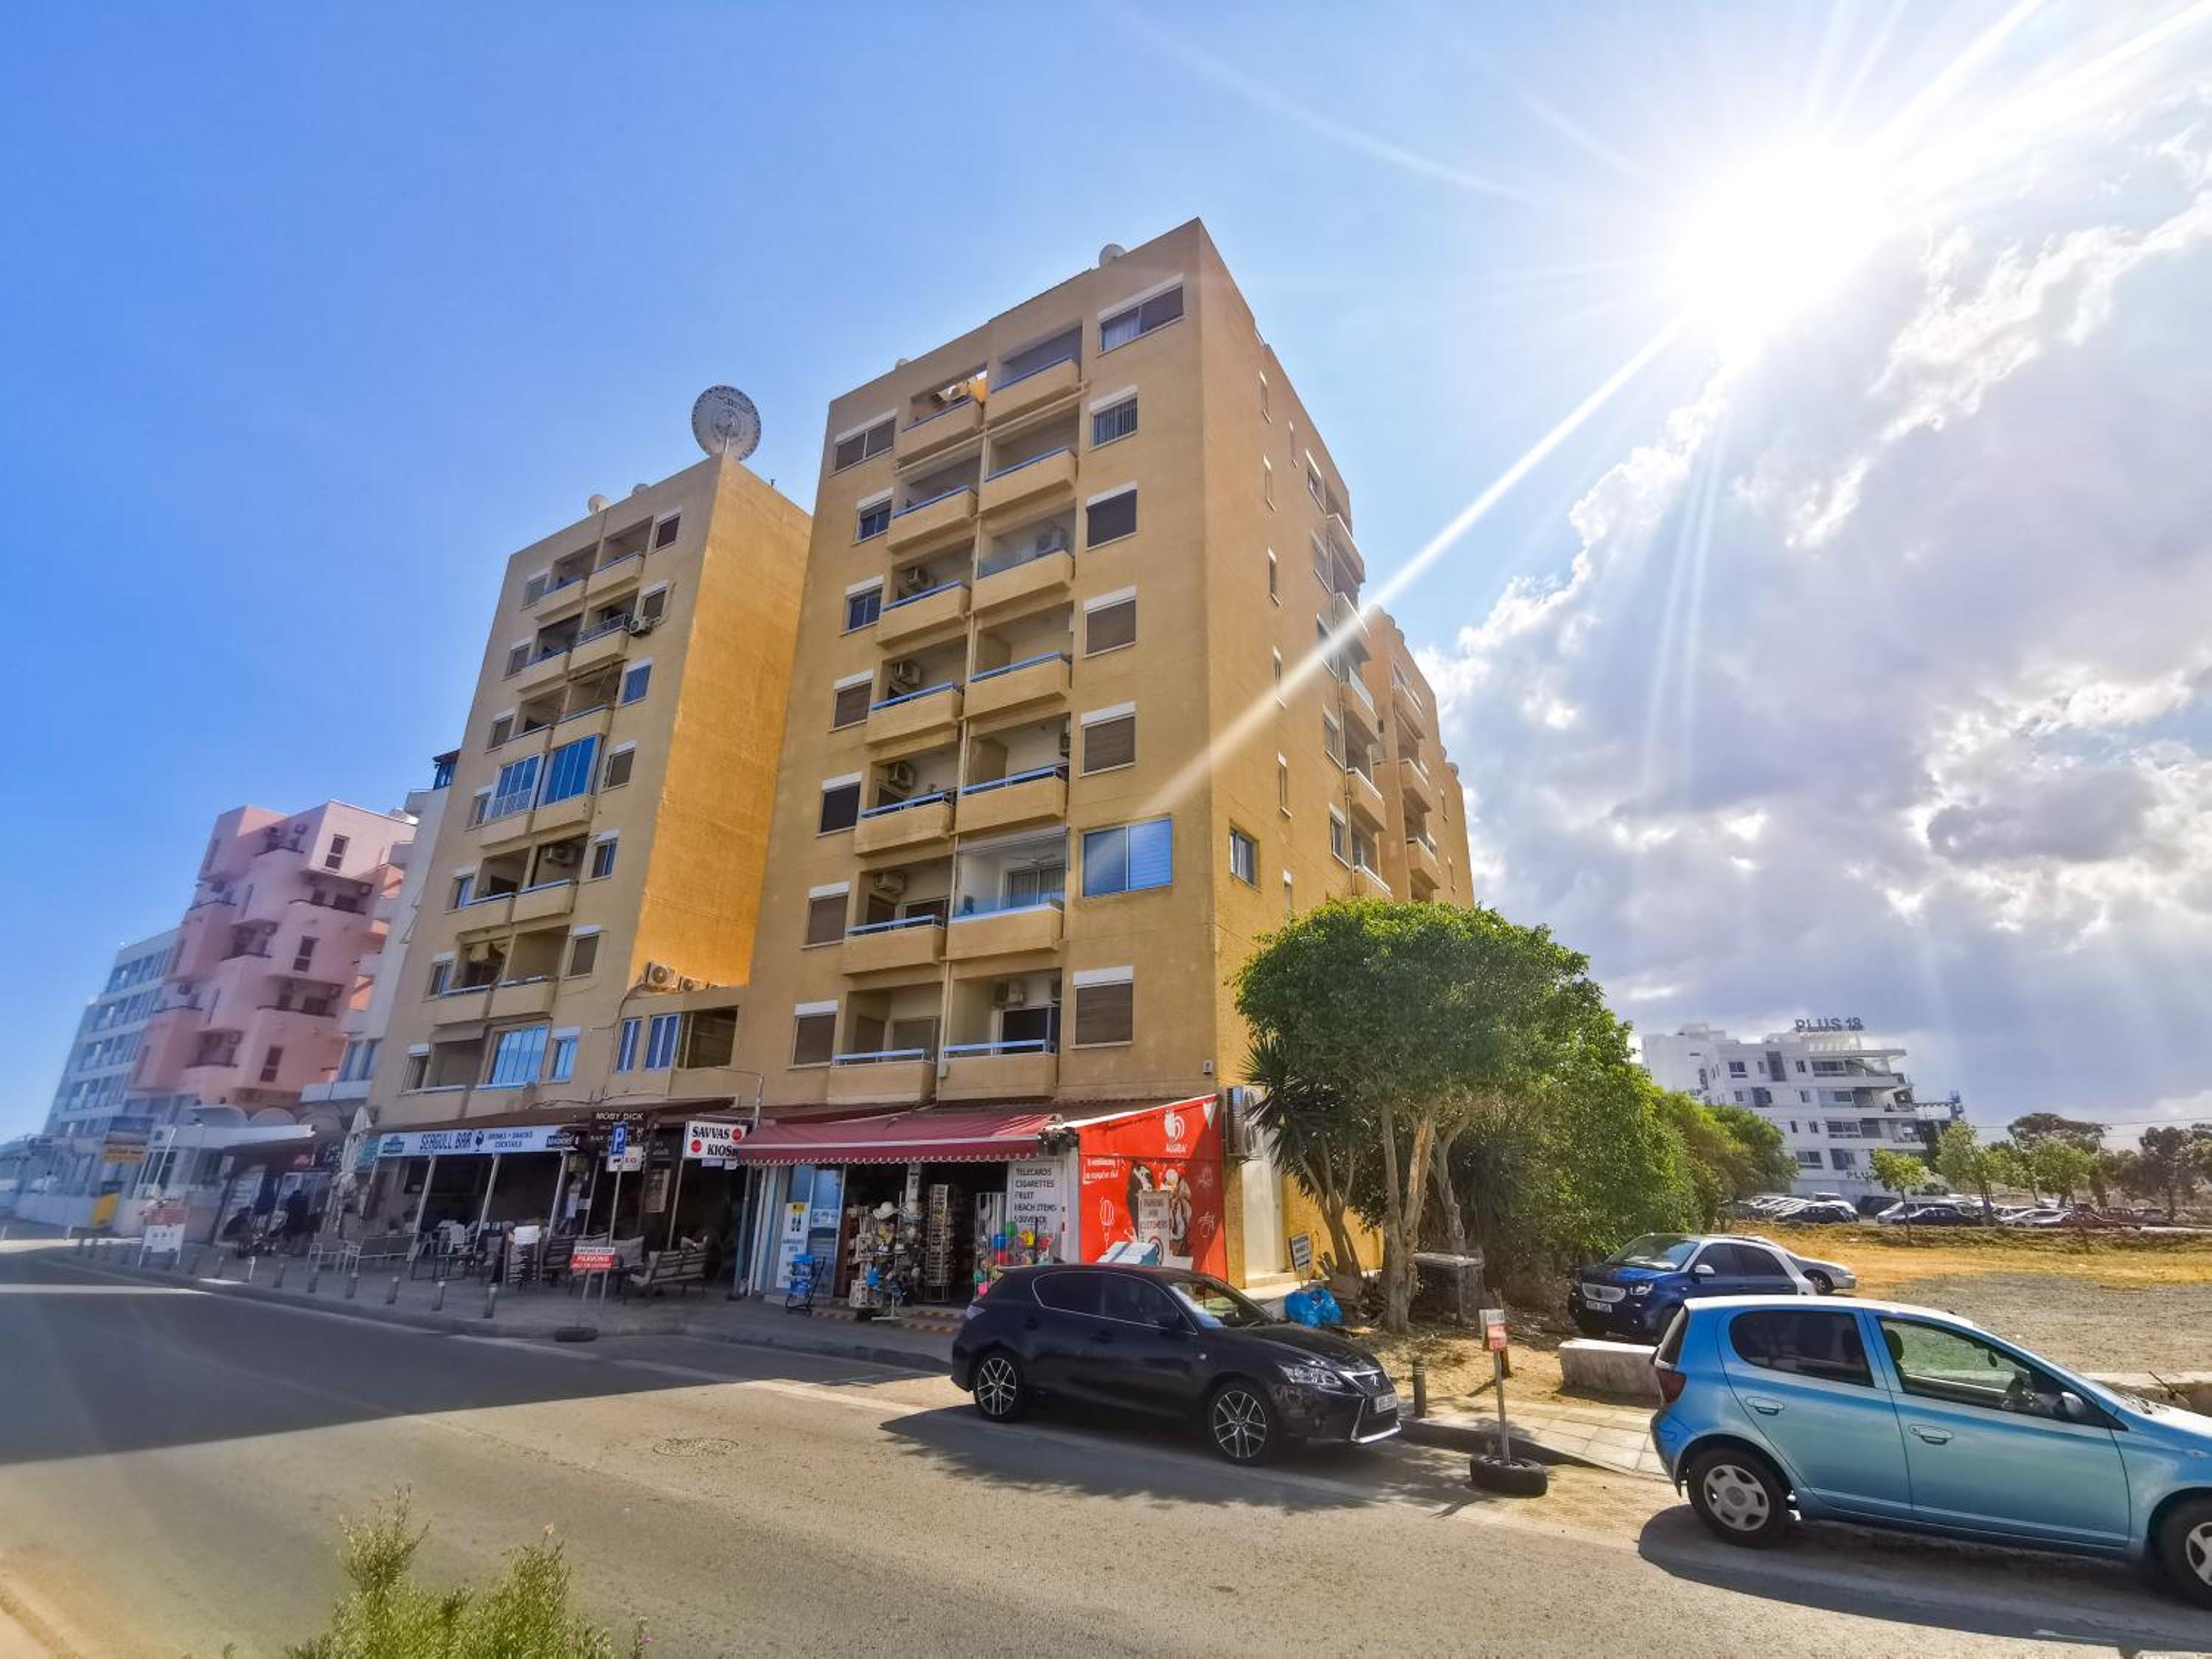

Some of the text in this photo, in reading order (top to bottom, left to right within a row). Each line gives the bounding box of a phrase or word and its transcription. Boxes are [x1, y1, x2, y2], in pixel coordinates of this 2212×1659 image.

[1795, 1017, 1863, 1032] PLUS 18
[596, 1111, 644, 1120] MOBY DICK
[692, 1126, 730, 1139] SAVVAS
[420, 1133, 453, 1150] SEAGULL
[455, 1132, 473, 1150] BAR
[1016, 1168, 1051, 1176] TELECARDS
[1015, 1180, 1054, 1188] CIGARETTES
[1015, 1192, 1034, 1200] FRUIT
